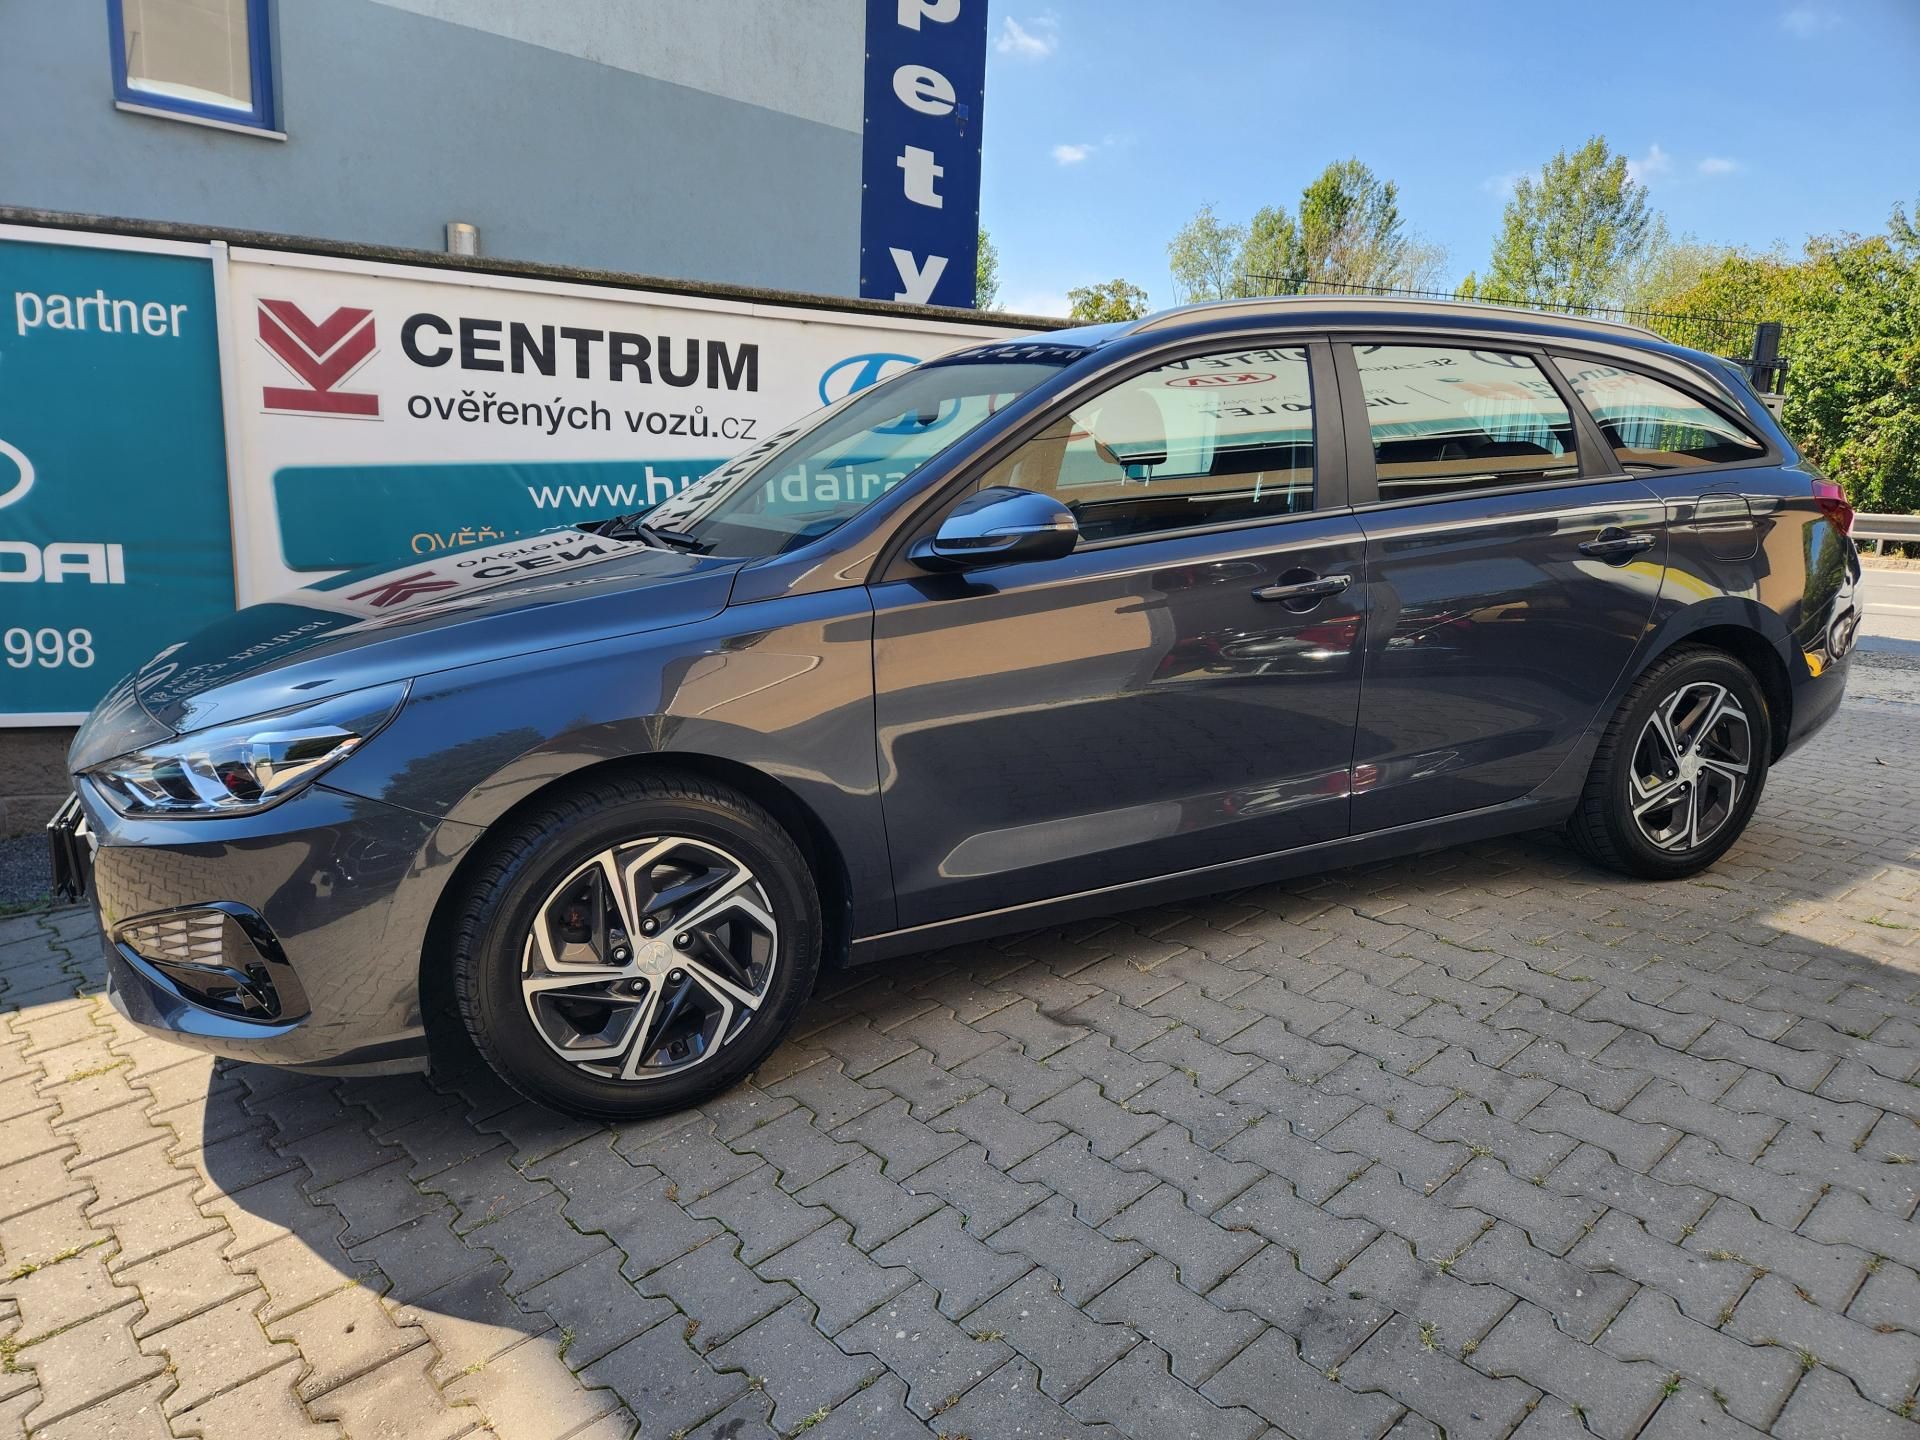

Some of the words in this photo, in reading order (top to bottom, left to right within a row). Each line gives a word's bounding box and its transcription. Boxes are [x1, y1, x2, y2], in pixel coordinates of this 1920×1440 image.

[15, 289, 188, 337] partner
[401, 313, 759, 393] CENTRUM
[407, 389, 611, 437] ověřených
[624, 405, 758, 440] vozů.cz
[4, 627, 95, 669] 998
